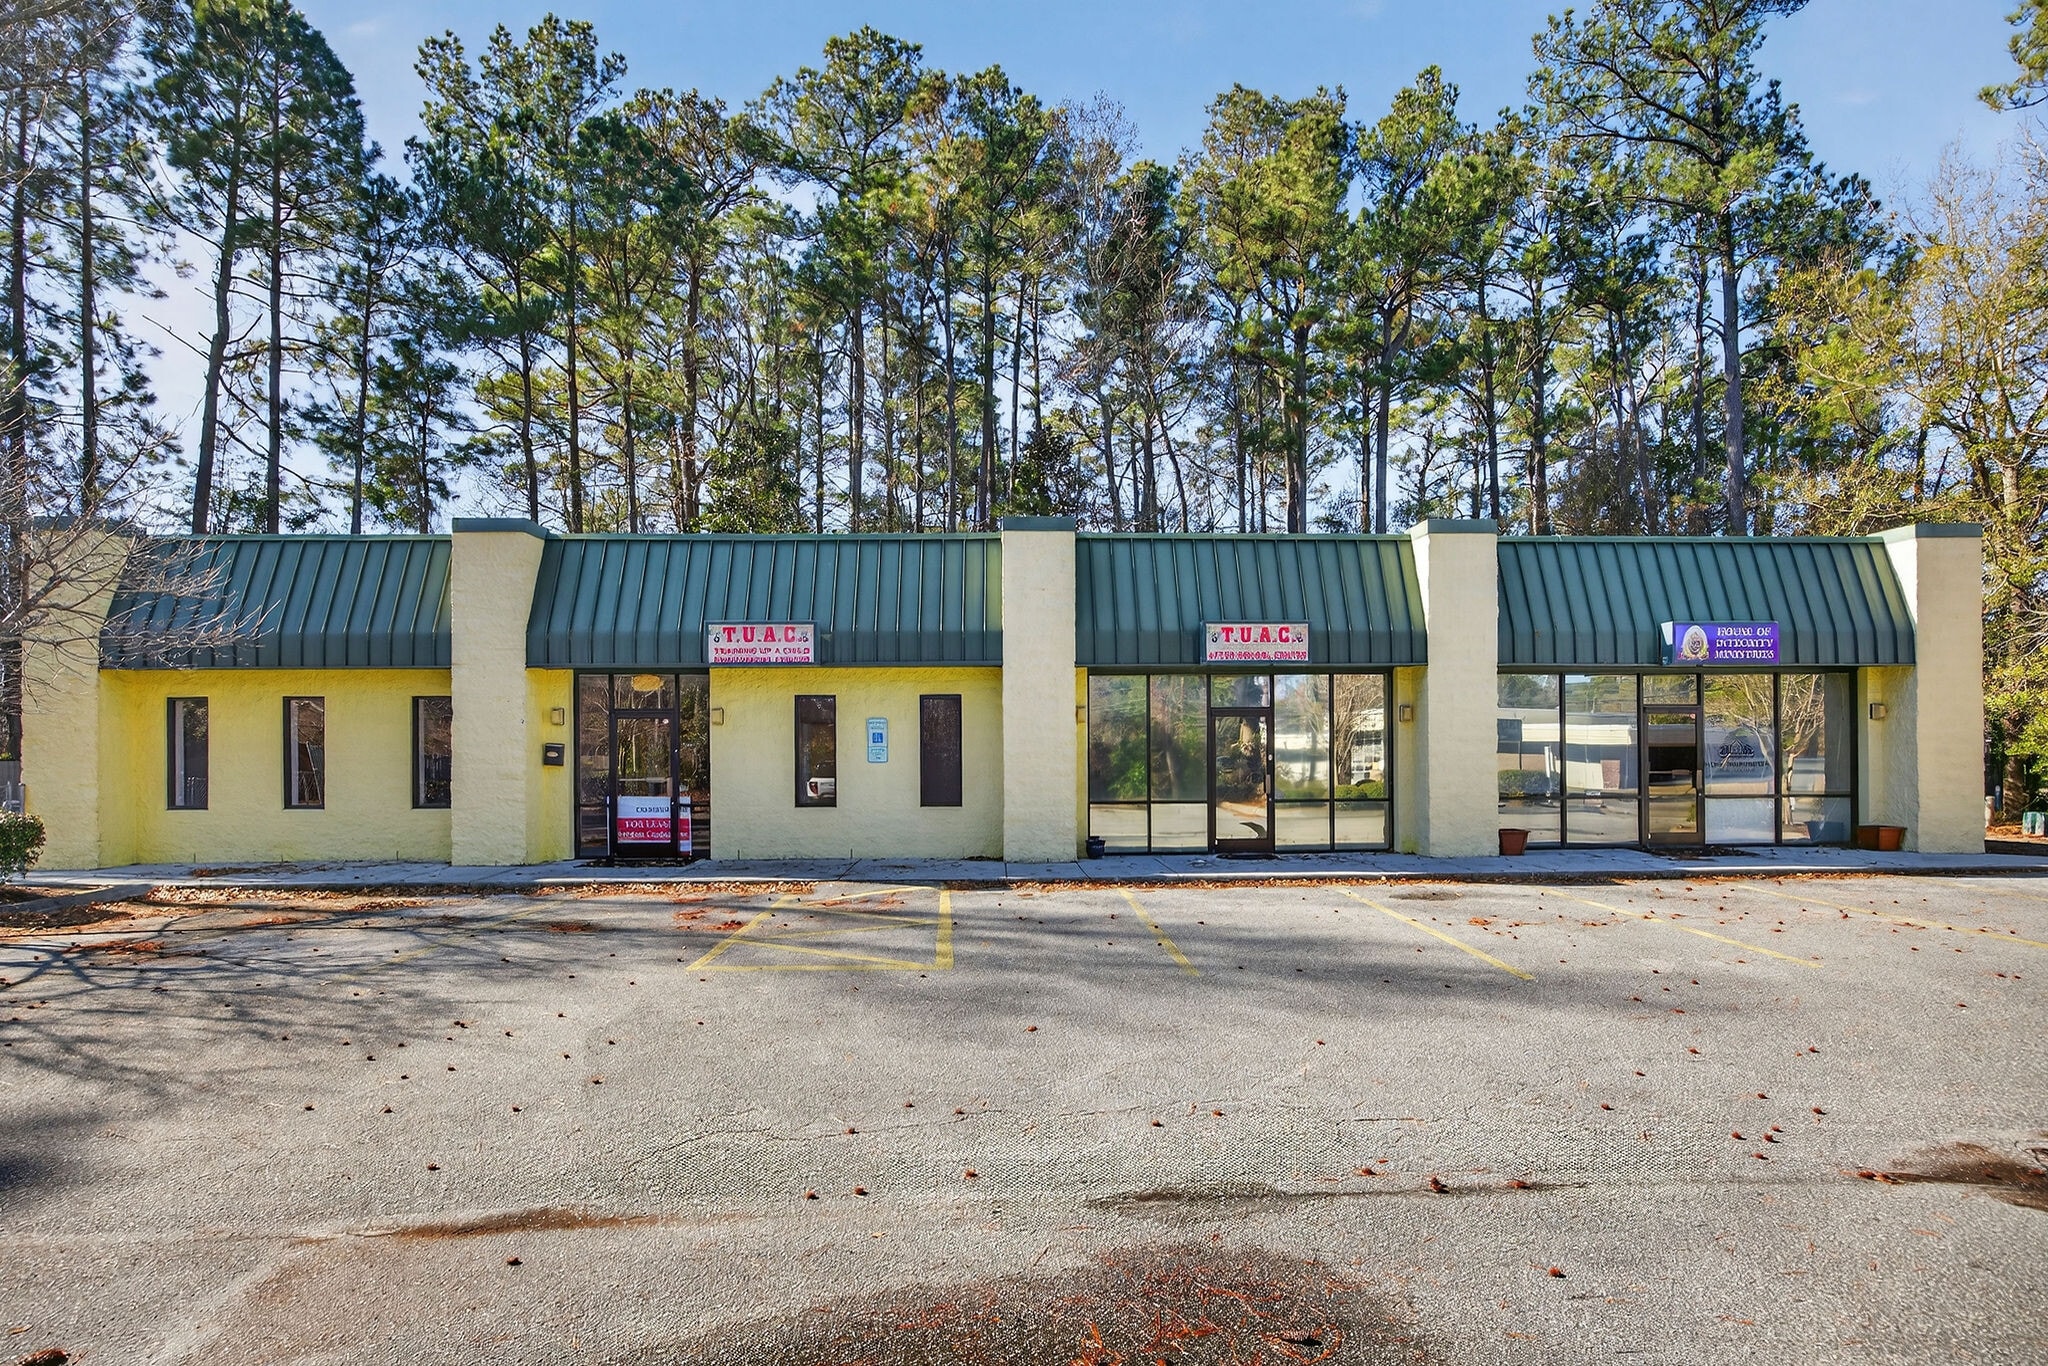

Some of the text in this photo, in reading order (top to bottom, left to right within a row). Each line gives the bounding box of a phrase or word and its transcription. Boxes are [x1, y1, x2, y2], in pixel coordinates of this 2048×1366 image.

[1717, 627, 1772, 636] HOUSE OF
[1714, 650, 1774, 659] MINISTRIES
[646, 820, 671, 828] LEAS
